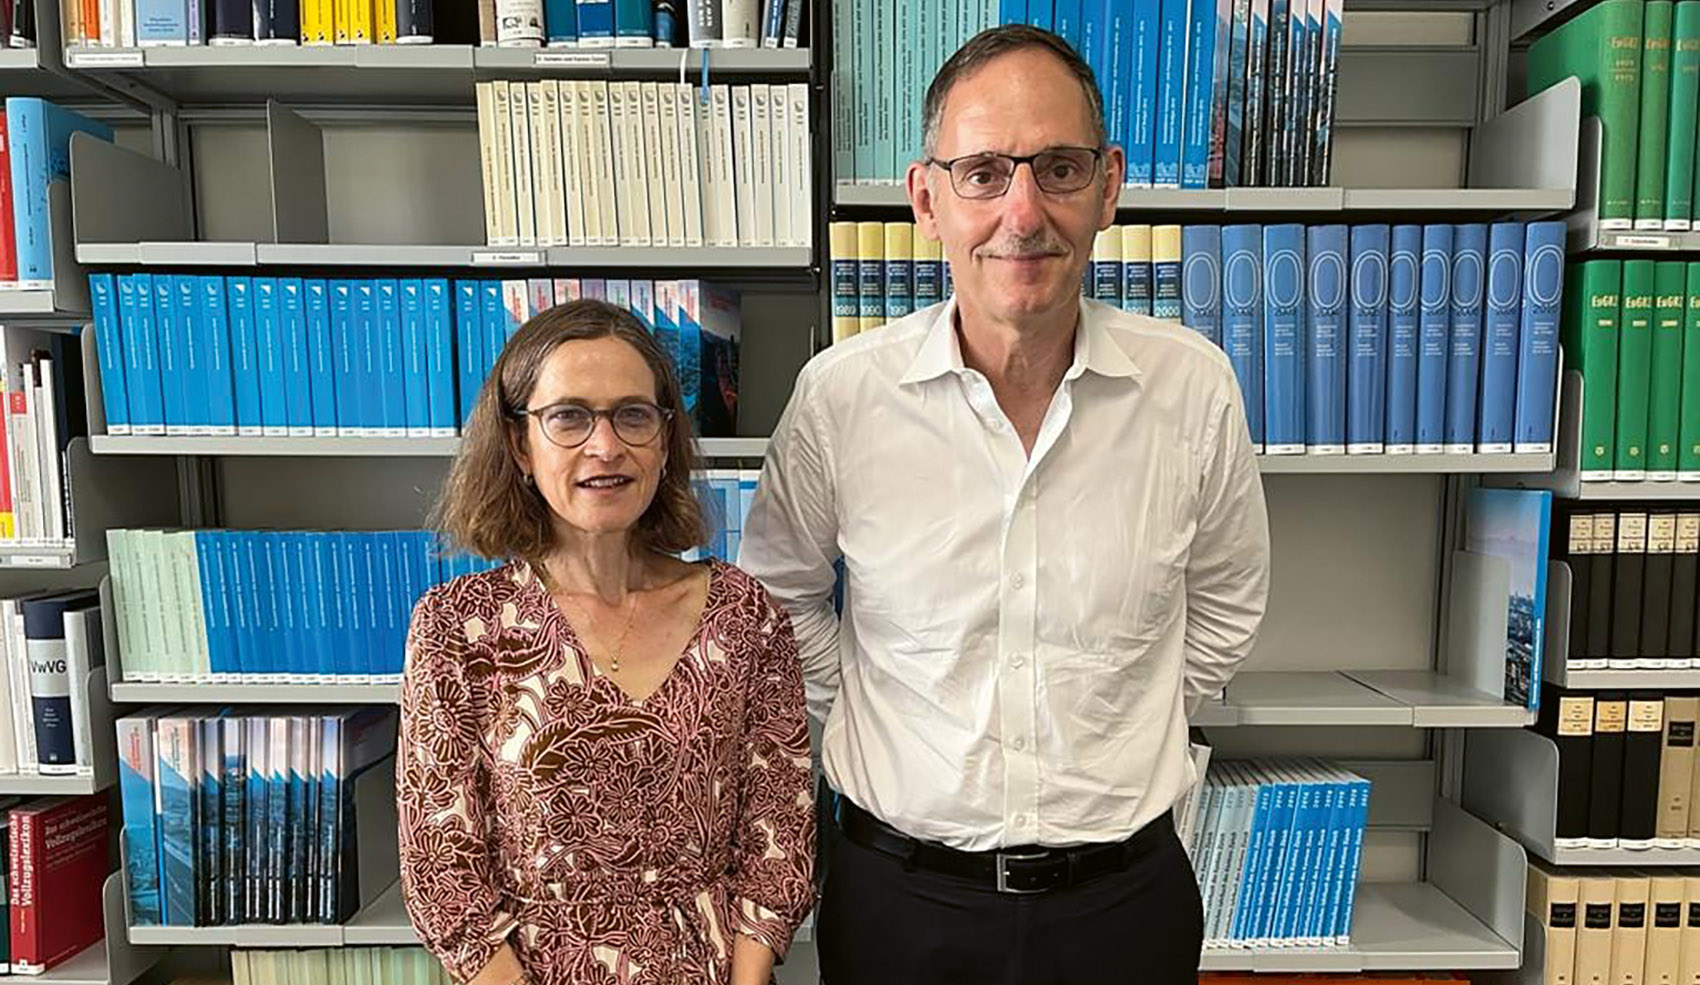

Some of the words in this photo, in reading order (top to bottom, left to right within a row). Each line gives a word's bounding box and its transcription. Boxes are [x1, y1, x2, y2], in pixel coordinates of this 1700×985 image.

[1157, 306, 1180, 317] 2000
[31, 660, 67, 673] VwVG
[21, 815, 34, 906] Vollzugslexikon
[10, 888, 19, 905] Das
